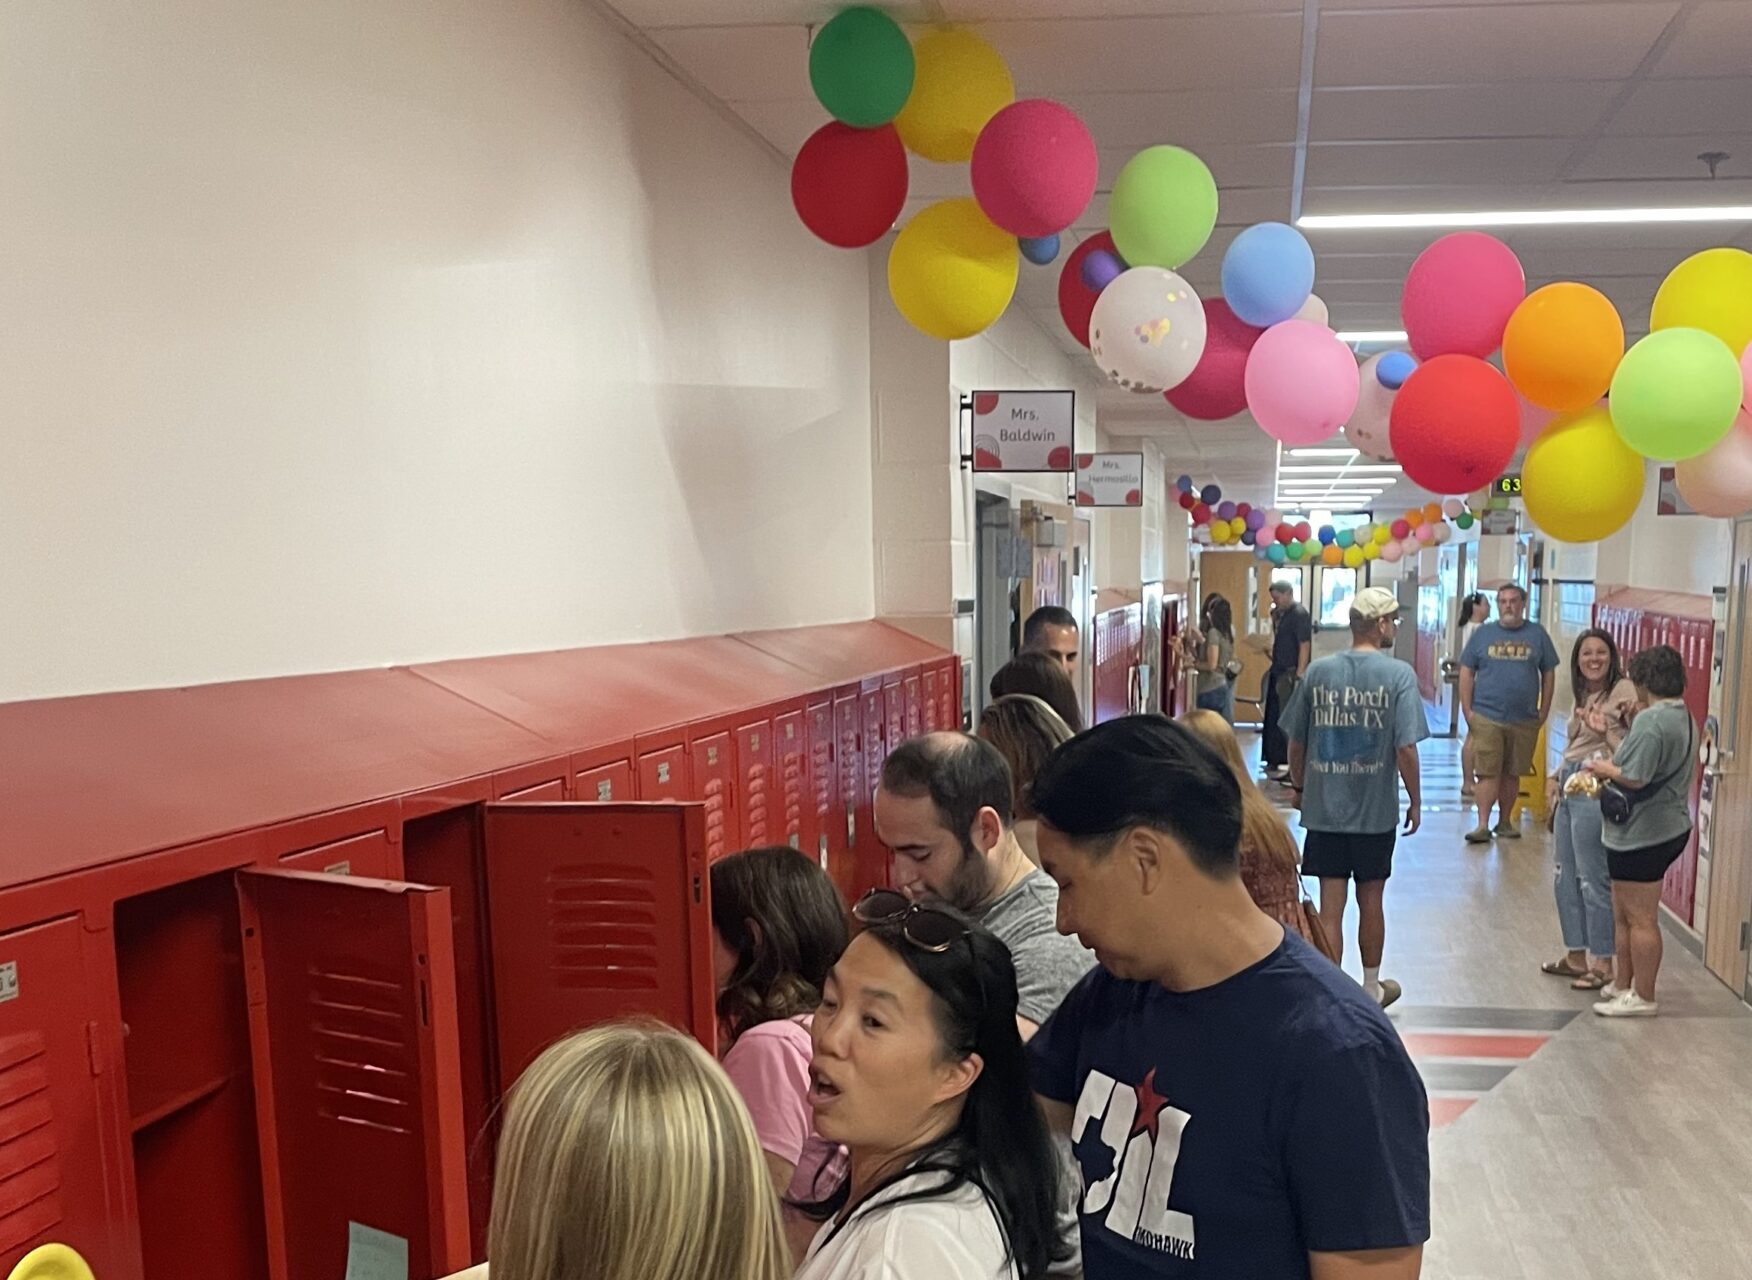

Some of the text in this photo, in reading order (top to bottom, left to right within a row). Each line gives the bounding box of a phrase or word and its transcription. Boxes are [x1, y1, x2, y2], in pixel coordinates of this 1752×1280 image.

[1011, 408, 1039, 420] Mrs.
[1000, 428, 1055, 441] Baldwin
[1313, 685, 1389, 709] The Porch
[1363, 708, 1384, 729] TX
[1133, 1227, 1194, 1260] MOHAWK
